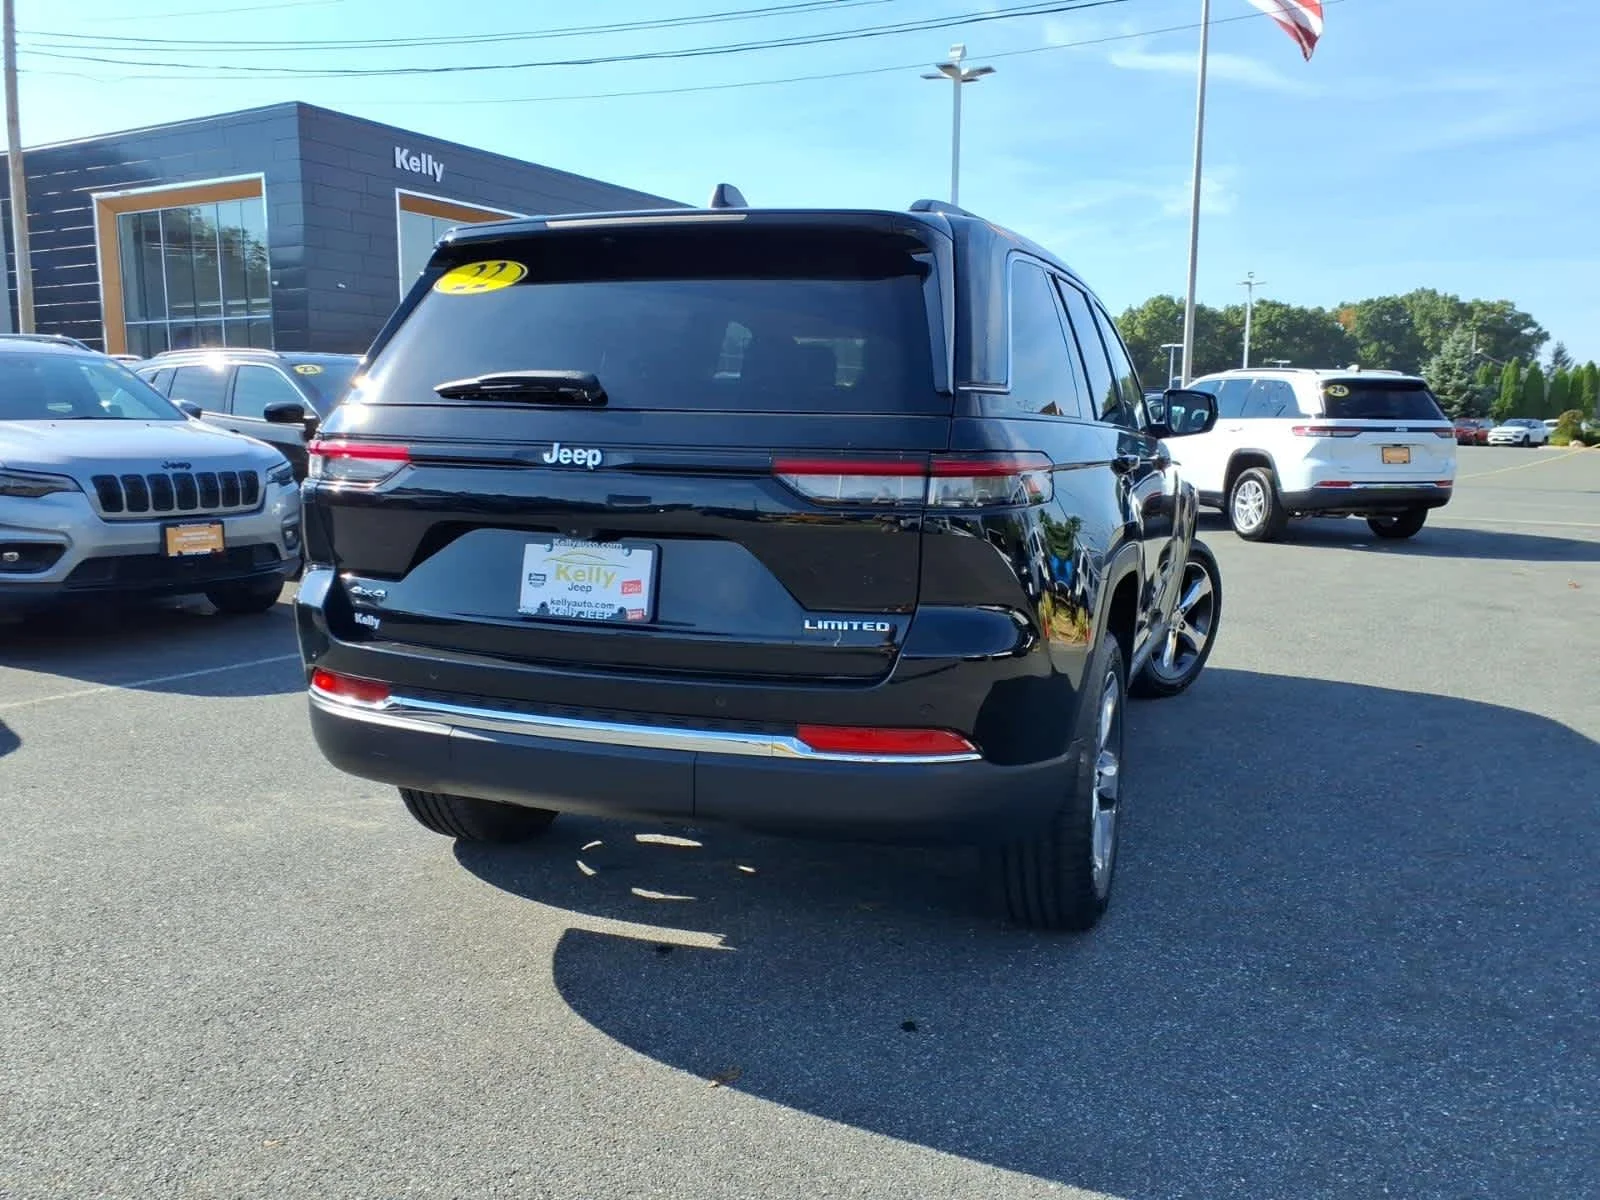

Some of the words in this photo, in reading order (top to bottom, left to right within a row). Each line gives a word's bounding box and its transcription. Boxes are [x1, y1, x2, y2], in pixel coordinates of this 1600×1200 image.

[394, 146, 444, 182] Kelly
[543, 442, 602, 470] Jeep
[161, 460, 192, 470] Jeep
[555, 563, 617, 588] Kelly
[567, 583, 593, 594] Jeep
[550, 597, 616, 610] kellyauto.com
[549, 606, 579, 618] Kelly
[579, 608, 613, 620] JEEP
[354, 612, 381, 630] Kelly
[804, 619, 890, 632] LIMITED
